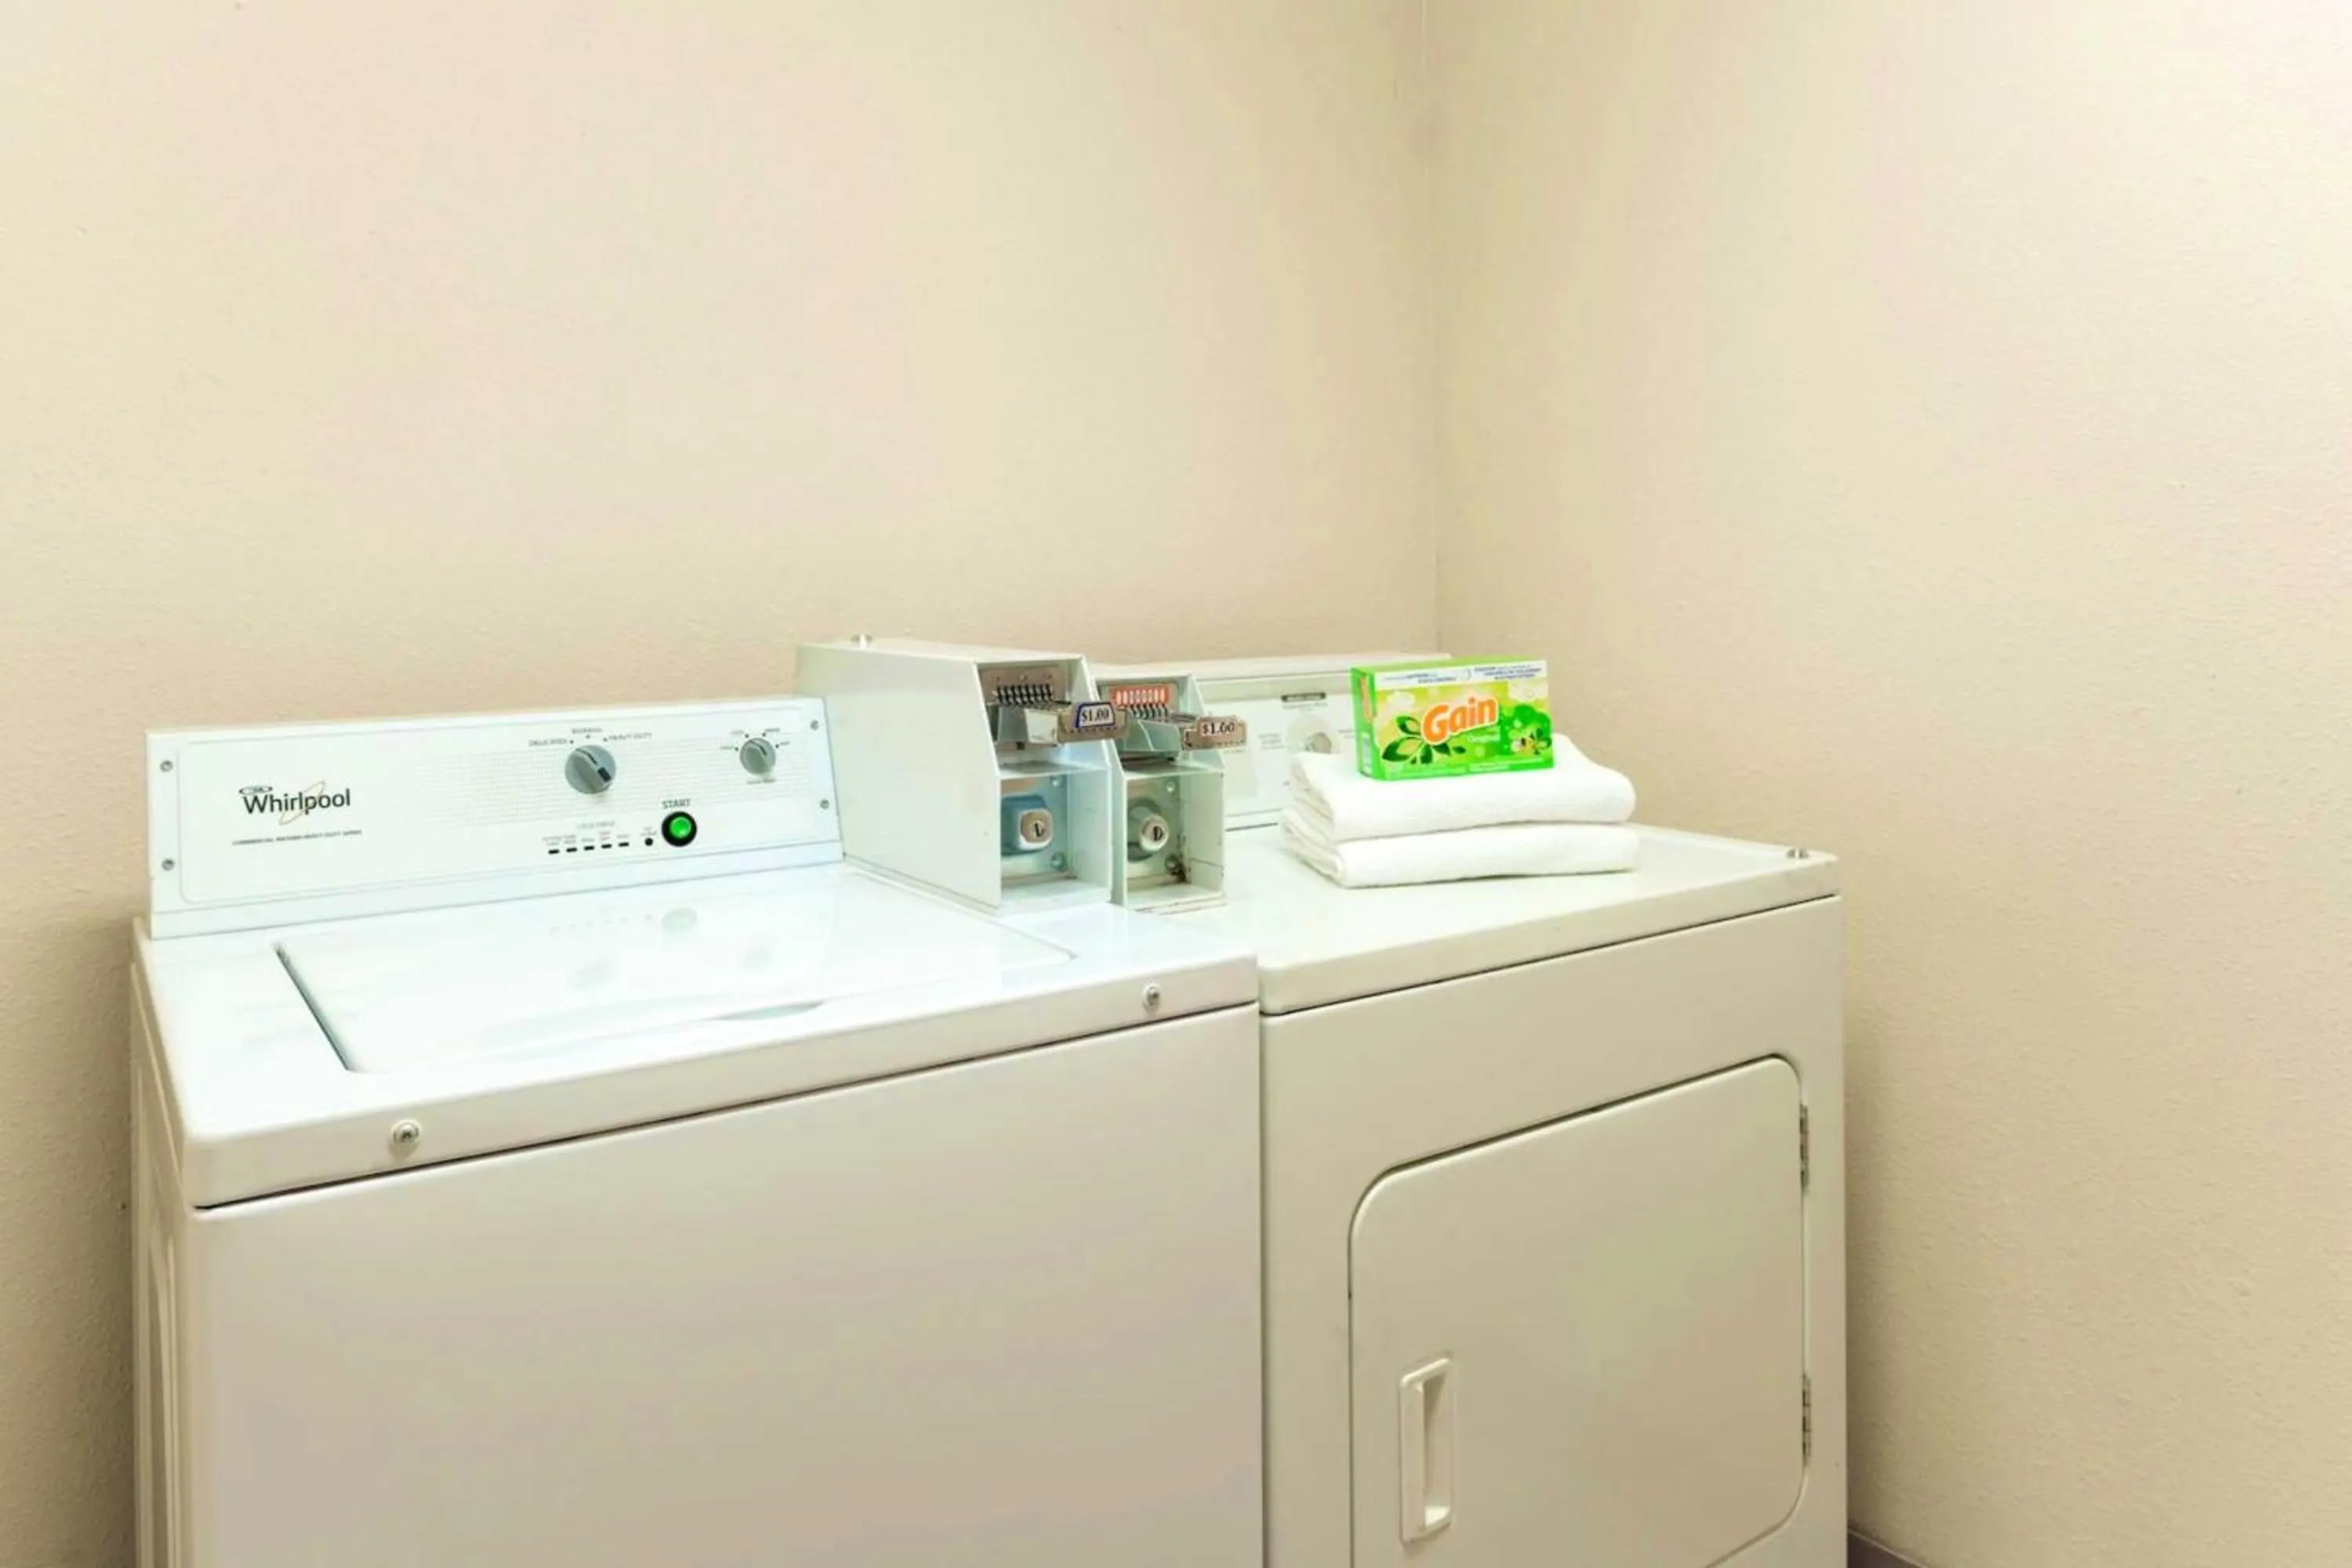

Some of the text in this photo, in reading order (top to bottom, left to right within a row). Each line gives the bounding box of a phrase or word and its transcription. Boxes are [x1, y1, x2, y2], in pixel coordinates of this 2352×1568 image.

[1422, 695, 1497, 743] Gain
[242, 787, 350, 816] Whirlpool
[662, 798, 691, 810] START
